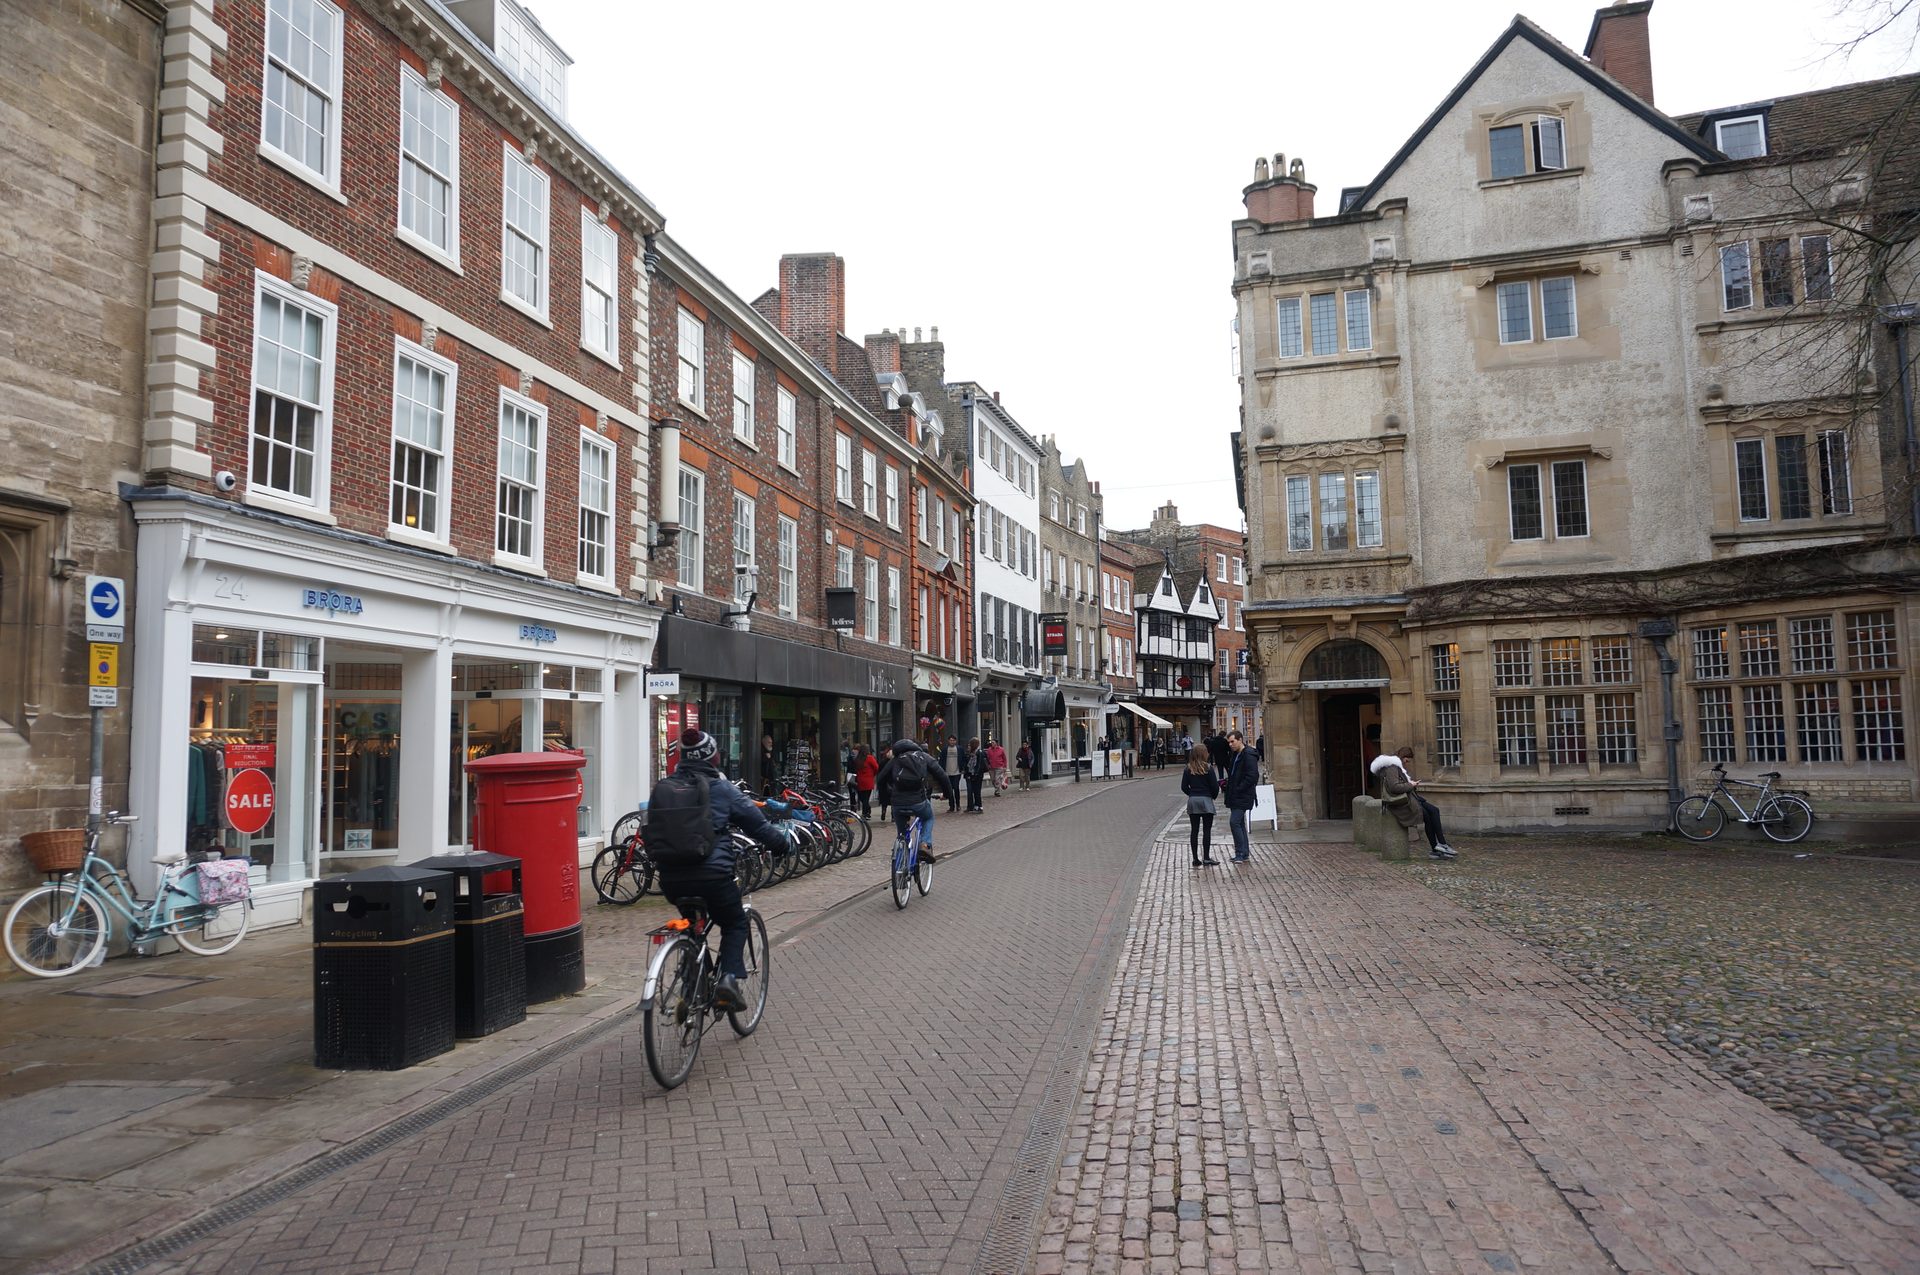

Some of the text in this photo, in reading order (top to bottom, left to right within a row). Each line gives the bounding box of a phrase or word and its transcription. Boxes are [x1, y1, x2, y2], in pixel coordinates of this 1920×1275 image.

[214, 574, 248, 601] 24
[1305, 575, 1372, 591] REISS
[303, 589, 364, 613] BRORA
[89, 629, 121, 639] One way
[519, 624, 557, 642] BRORA
[234, 759, 267, 767] REDUCTIONS
[229, 793, 272, 809] SALE
[335, 929, 378, 939] Recycling
